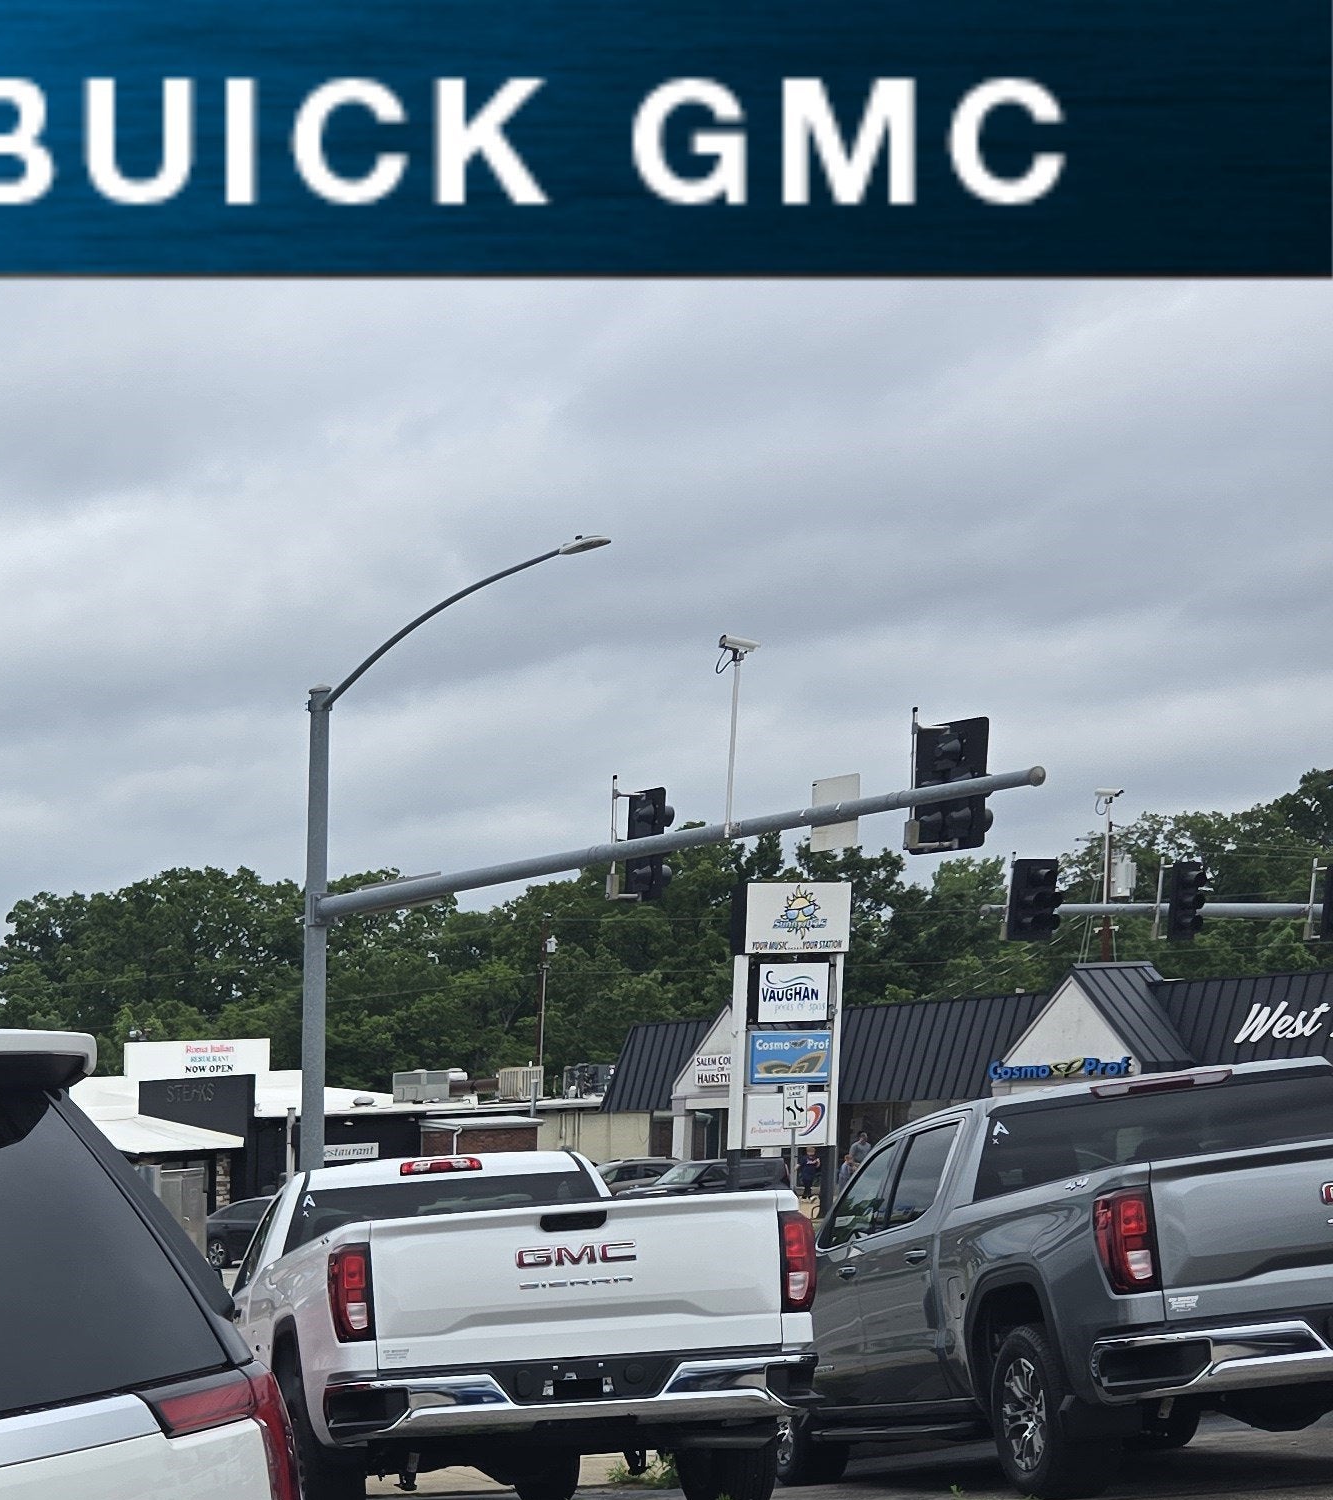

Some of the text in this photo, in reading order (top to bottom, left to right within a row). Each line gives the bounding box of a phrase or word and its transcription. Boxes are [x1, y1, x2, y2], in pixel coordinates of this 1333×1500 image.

[752, 941, 768, 951] YOUR
[819, 939, 843, 949] STATION
[761, 986, 819, 1002] VAUGHAN
[1233, 1001, 1331, 1044] West
[755, 1038, 830, 1051] Cosmo Prof
[696, 1056, 717, 1067] SALEM
[989, 1056, 1132, 1080] Cosmo Prof
[184, 1064, 234, 1074] NOW OPEN
[324, 1145, 375, 1158] estaurant
[514, 1239, 637, 1270] GMC
[518, 1274, 634, 1290] SIERRA
